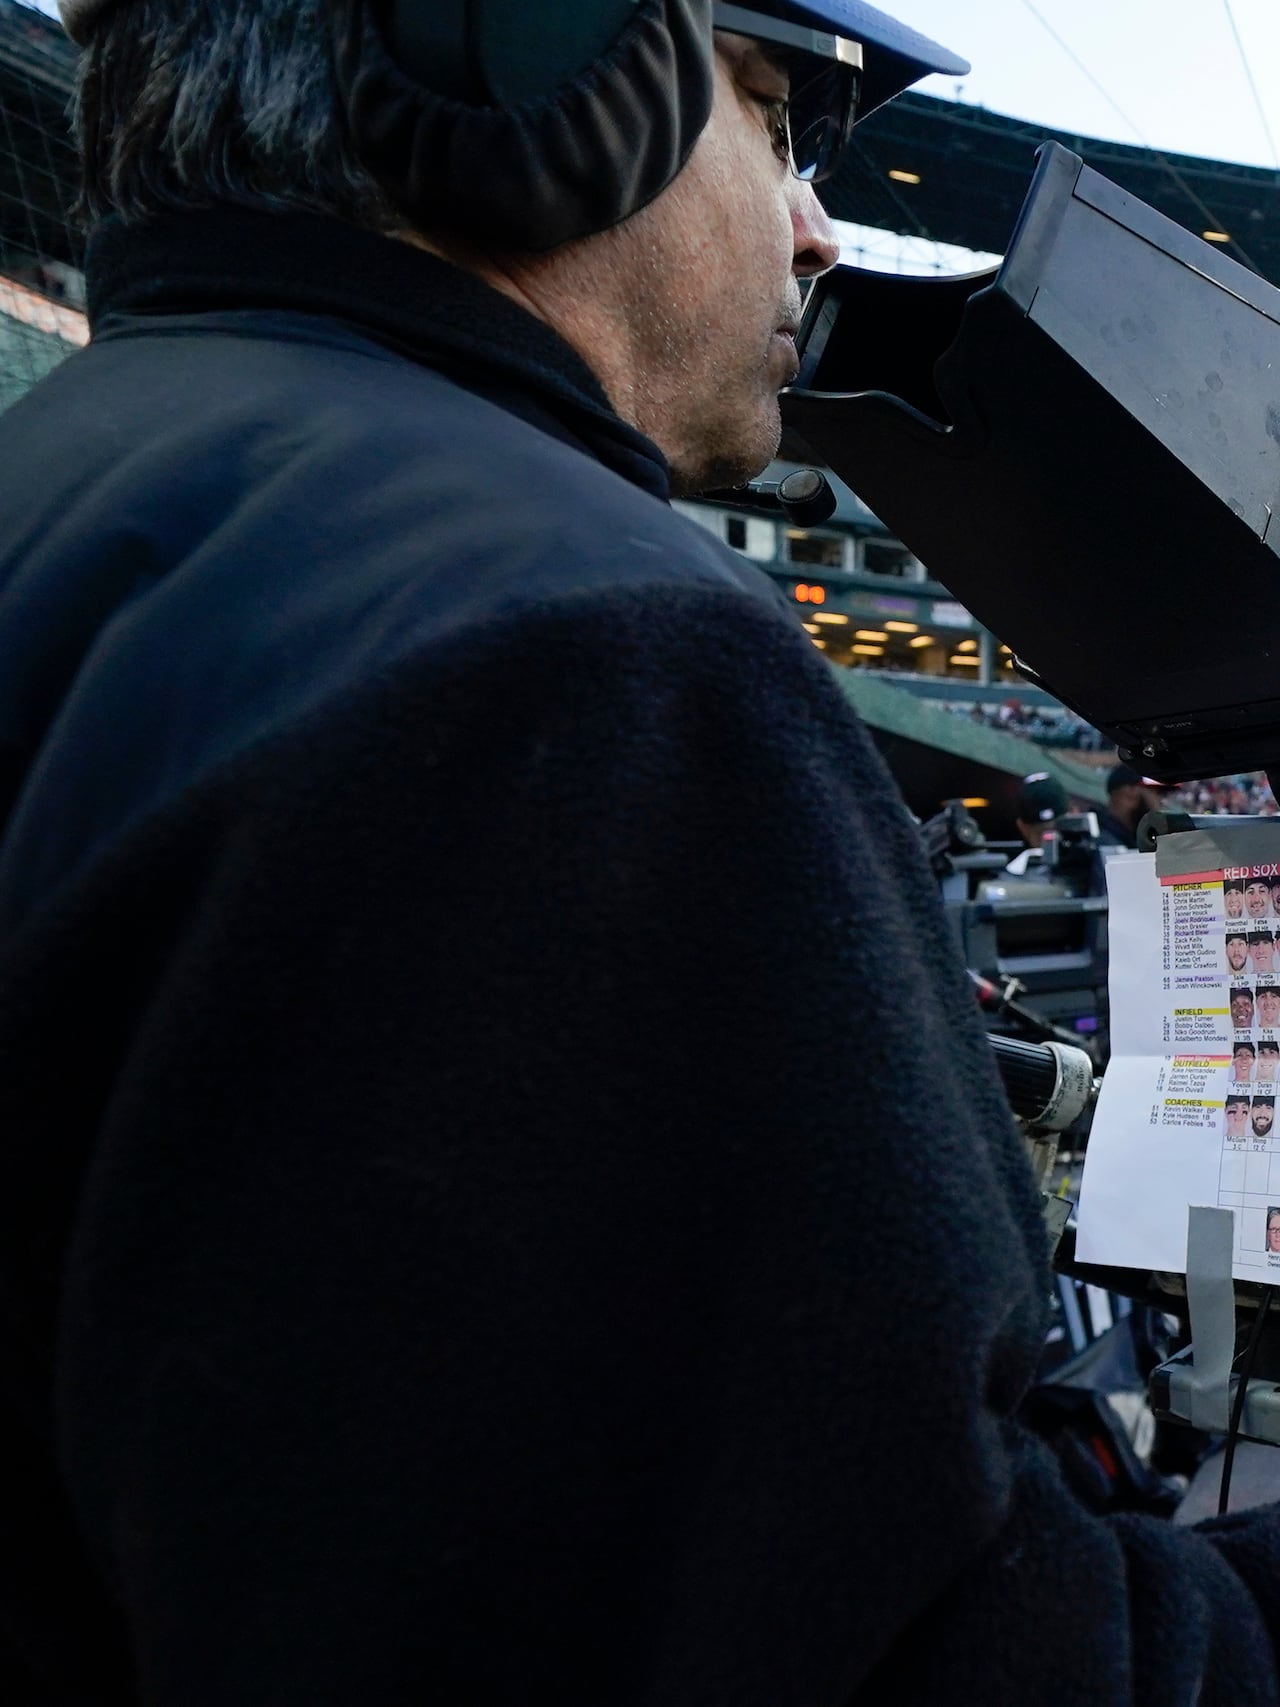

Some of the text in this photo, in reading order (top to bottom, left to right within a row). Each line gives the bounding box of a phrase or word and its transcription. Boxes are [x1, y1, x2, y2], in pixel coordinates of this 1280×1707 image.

[1223, 863, 1279, 880] RED SOX
[1173, 883, 1203, 892] PITCHER
[1174, 1008, 1203, 1016] INFIELD
[1165, 1098, 1202, 1106] COACHES
[1162, 1118, 1181, 1126] Carlos
